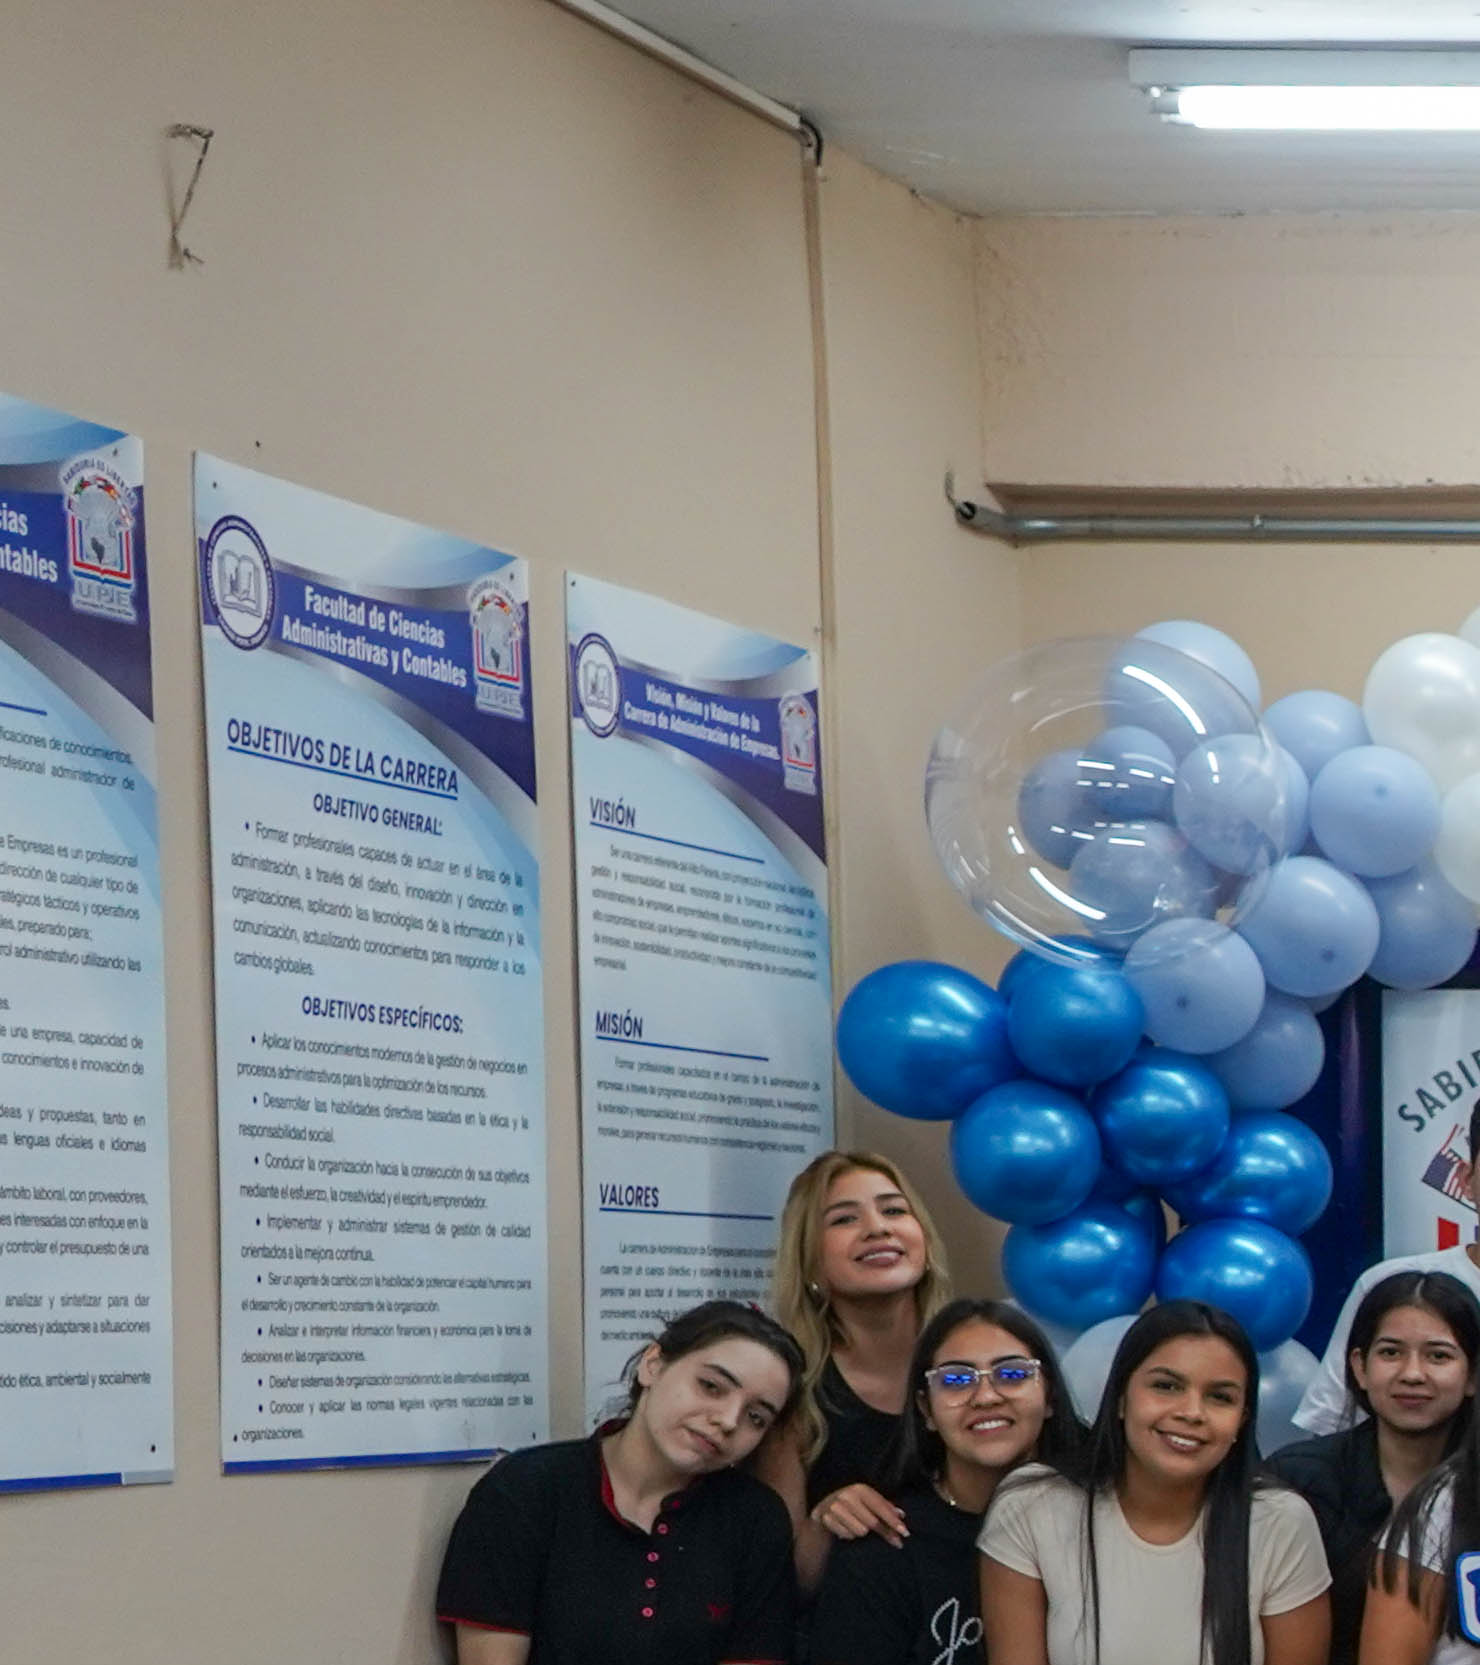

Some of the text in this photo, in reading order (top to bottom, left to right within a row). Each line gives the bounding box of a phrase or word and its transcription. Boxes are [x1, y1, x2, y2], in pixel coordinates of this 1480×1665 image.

[305, 585, 445, 648] Facultad de Ciencias
[282, 615, 467, 688] Administrativas y Contables
[227, 717, 459, 793] OBJETIVOS DE LA CARRERA
[313, 792, 443, 836] OBJETIVO GENERAL:
[590, 796, 636, 828] VISIÓN
[302, 996, 464, 1034] OBJETIVOS ESPECÍFICOS:
[596, 1009, 643, 1038] MISIÓN
[599, 1184, 660, 1208] VALORES
